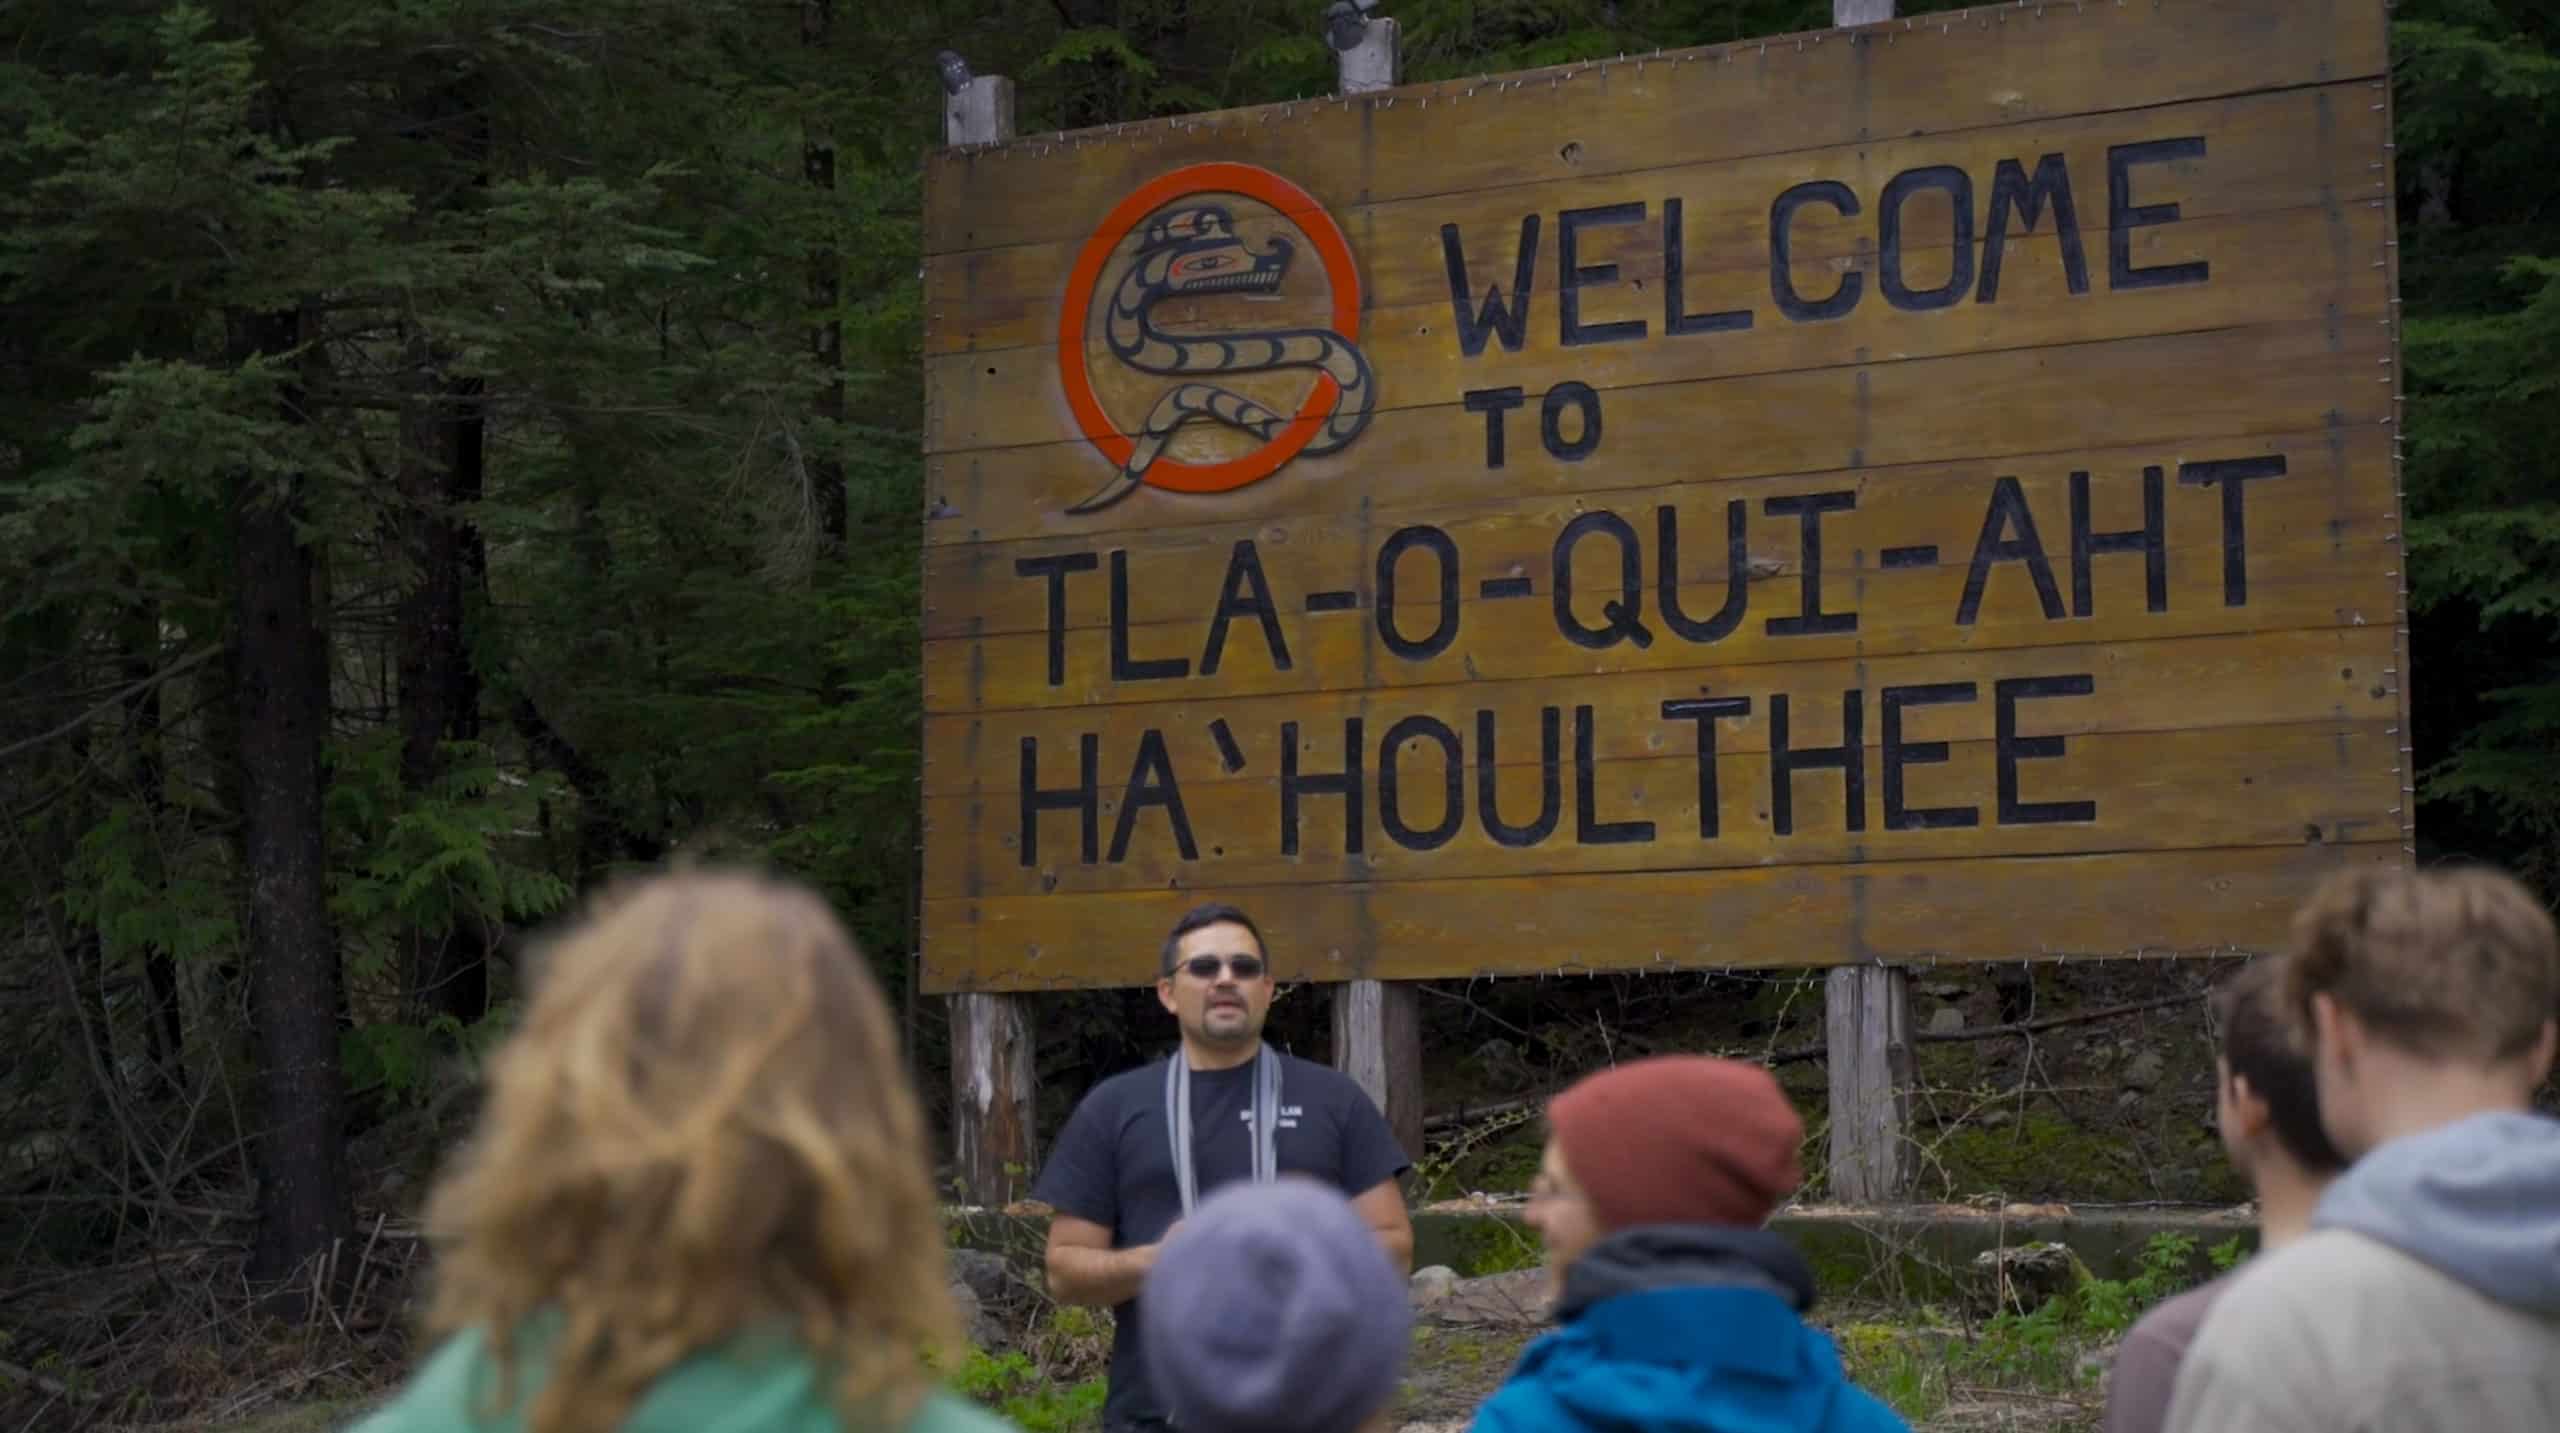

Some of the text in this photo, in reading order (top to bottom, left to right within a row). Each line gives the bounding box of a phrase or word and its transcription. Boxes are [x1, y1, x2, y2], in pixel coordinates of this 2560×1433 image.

[1440, 135, 2210, 357] WELCOME
[1463, 381, 1601, 469] TO
[1015, 454, 2287, 687] TLA-O-QUI-AHT
